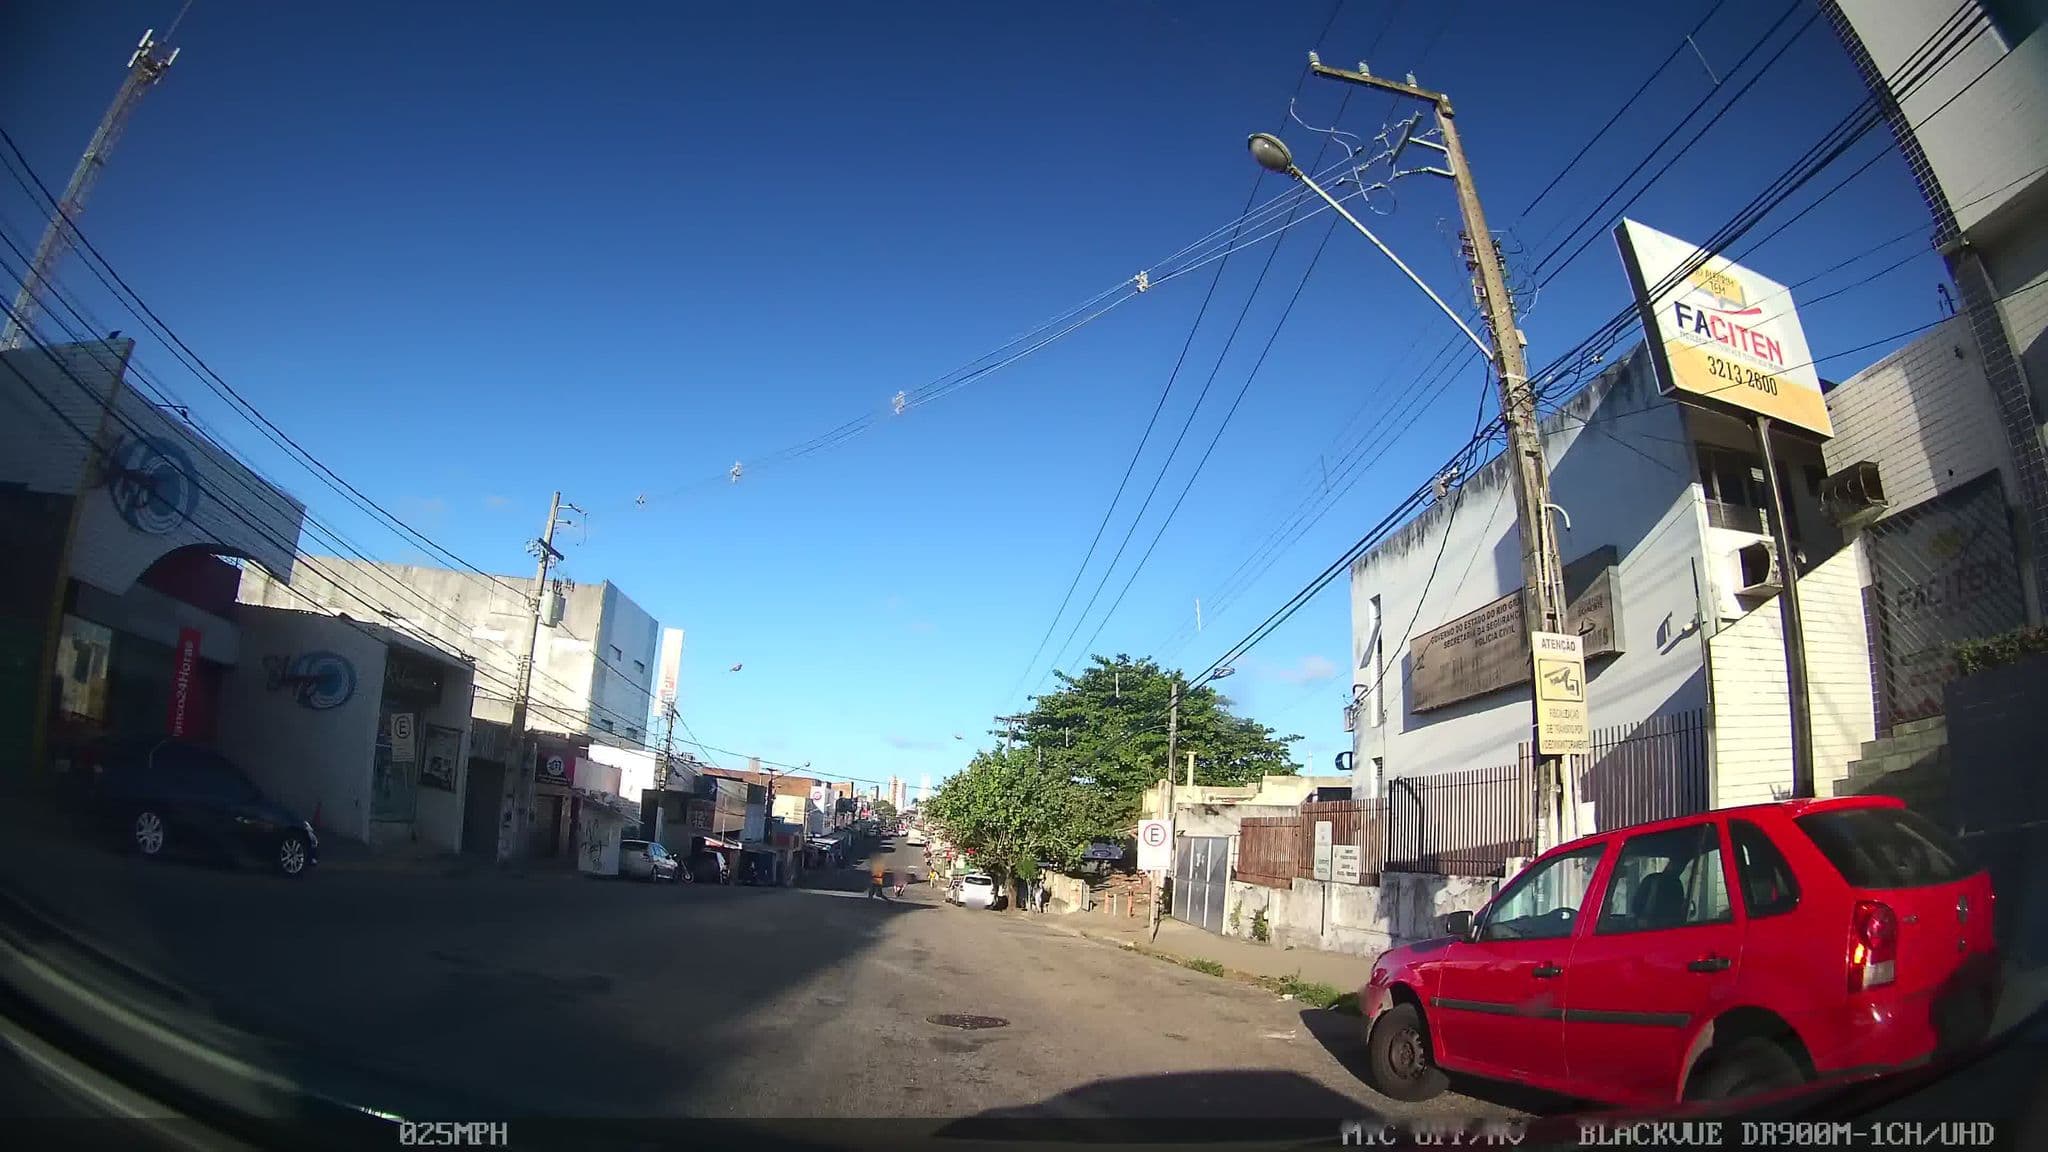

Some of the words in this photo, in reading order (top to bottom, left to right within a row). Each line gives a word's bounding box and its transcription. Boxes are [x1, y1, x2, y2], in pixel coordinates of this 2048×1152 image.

[1674, 301, 1783, 365] FACITEN
[1707, 355, 1743, 385] 3213
[1455, 624, 1463, 634] DO
[1464, 614, 1486, 630] ESTADO
[1487, 609, 1496, 619] DO
[1496, 603, 1507, 616] RIO
[1443, 629, 1476, 649] SECRETARIA
[399, 720, 407, 735] E
[1151, 828, 1159, 842] E
